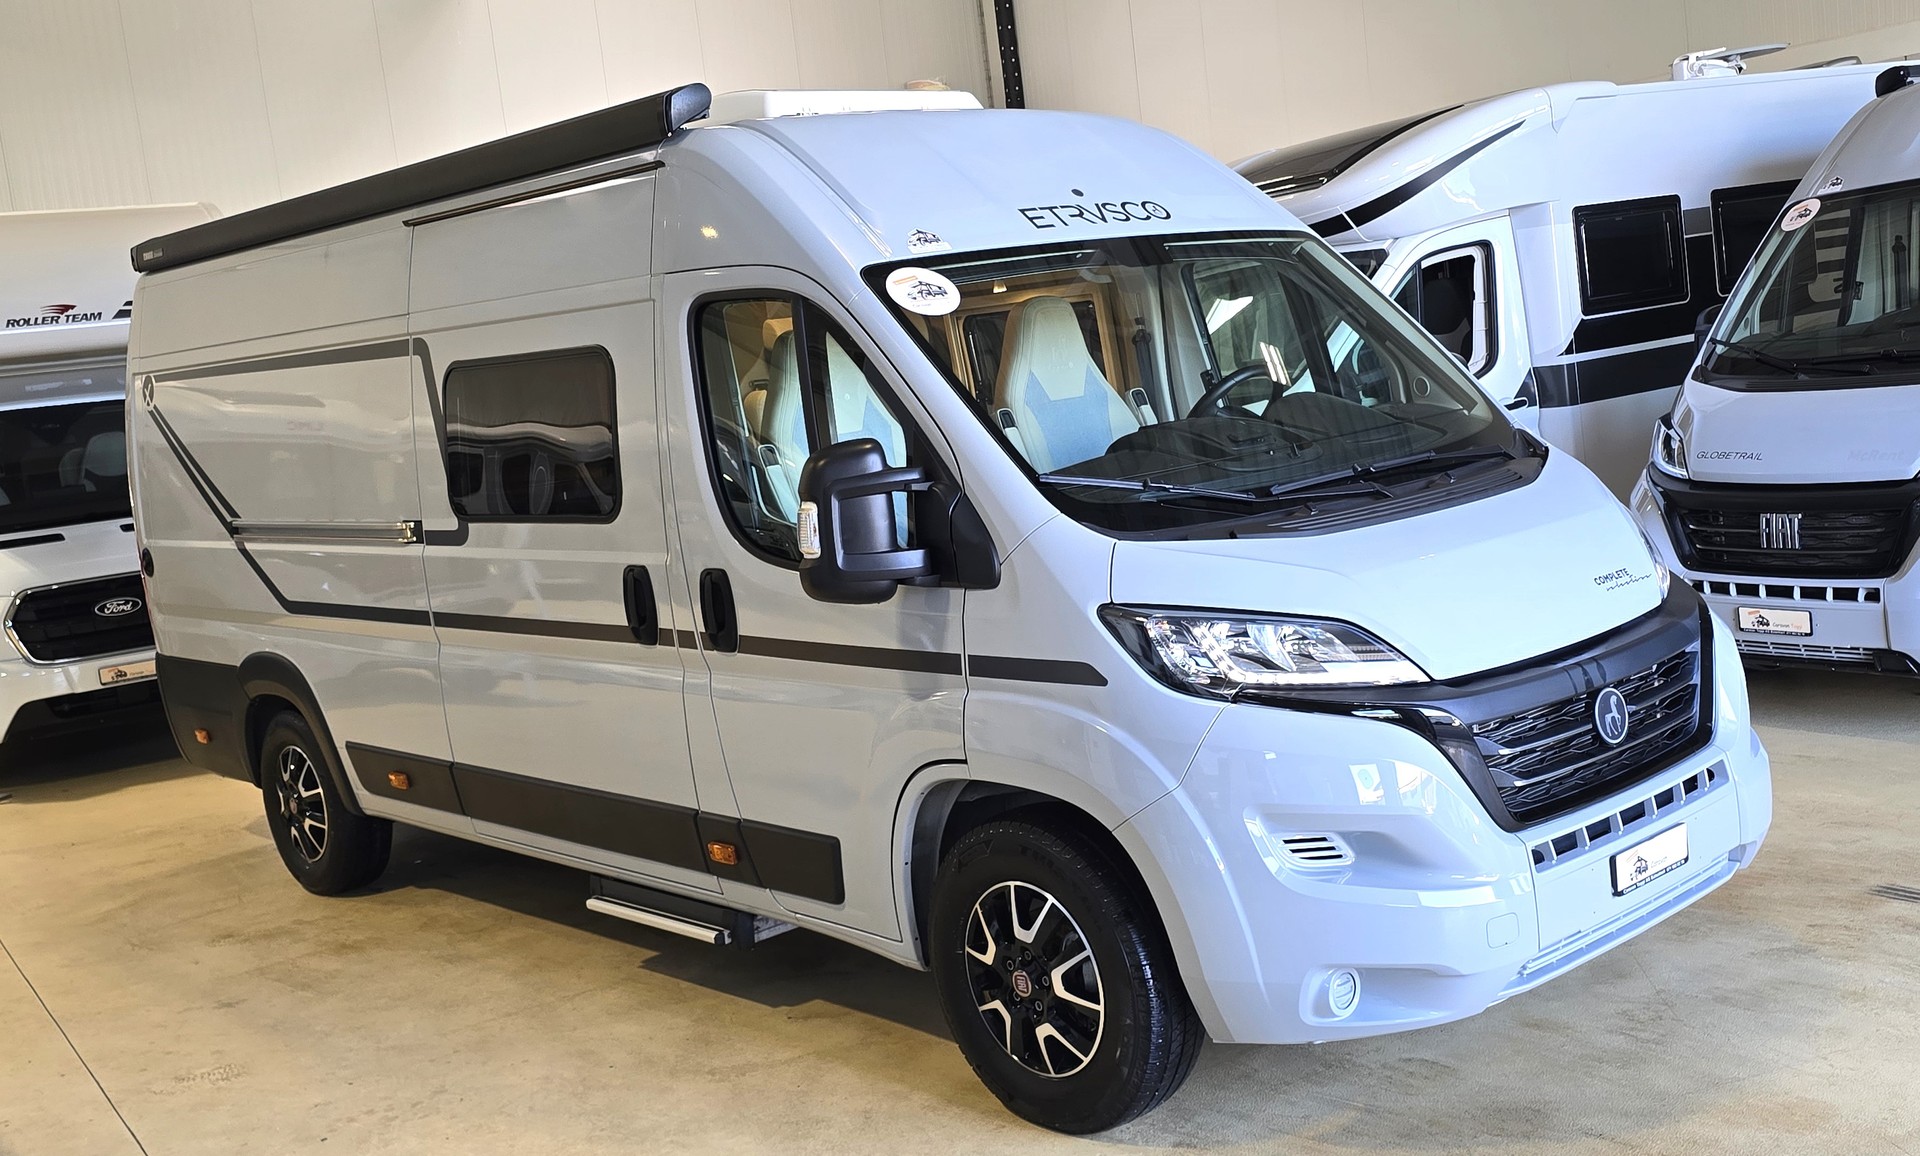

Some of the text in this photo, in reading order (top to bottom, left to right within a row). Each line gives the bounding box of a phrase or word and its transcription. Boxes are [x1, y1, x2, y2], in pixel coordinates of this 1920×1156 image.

[5, 311, 103, 329] ROLLER TEAM
[1696, 450, 1763, 462] GLOBETRAIL
[1759, 513, 1802, 549] FIAT
[1594, 567, 1630, 586] COMPLETE
[104, 601, 133, 614] Ford
[1016, 975, 1028, 993] FIAT
